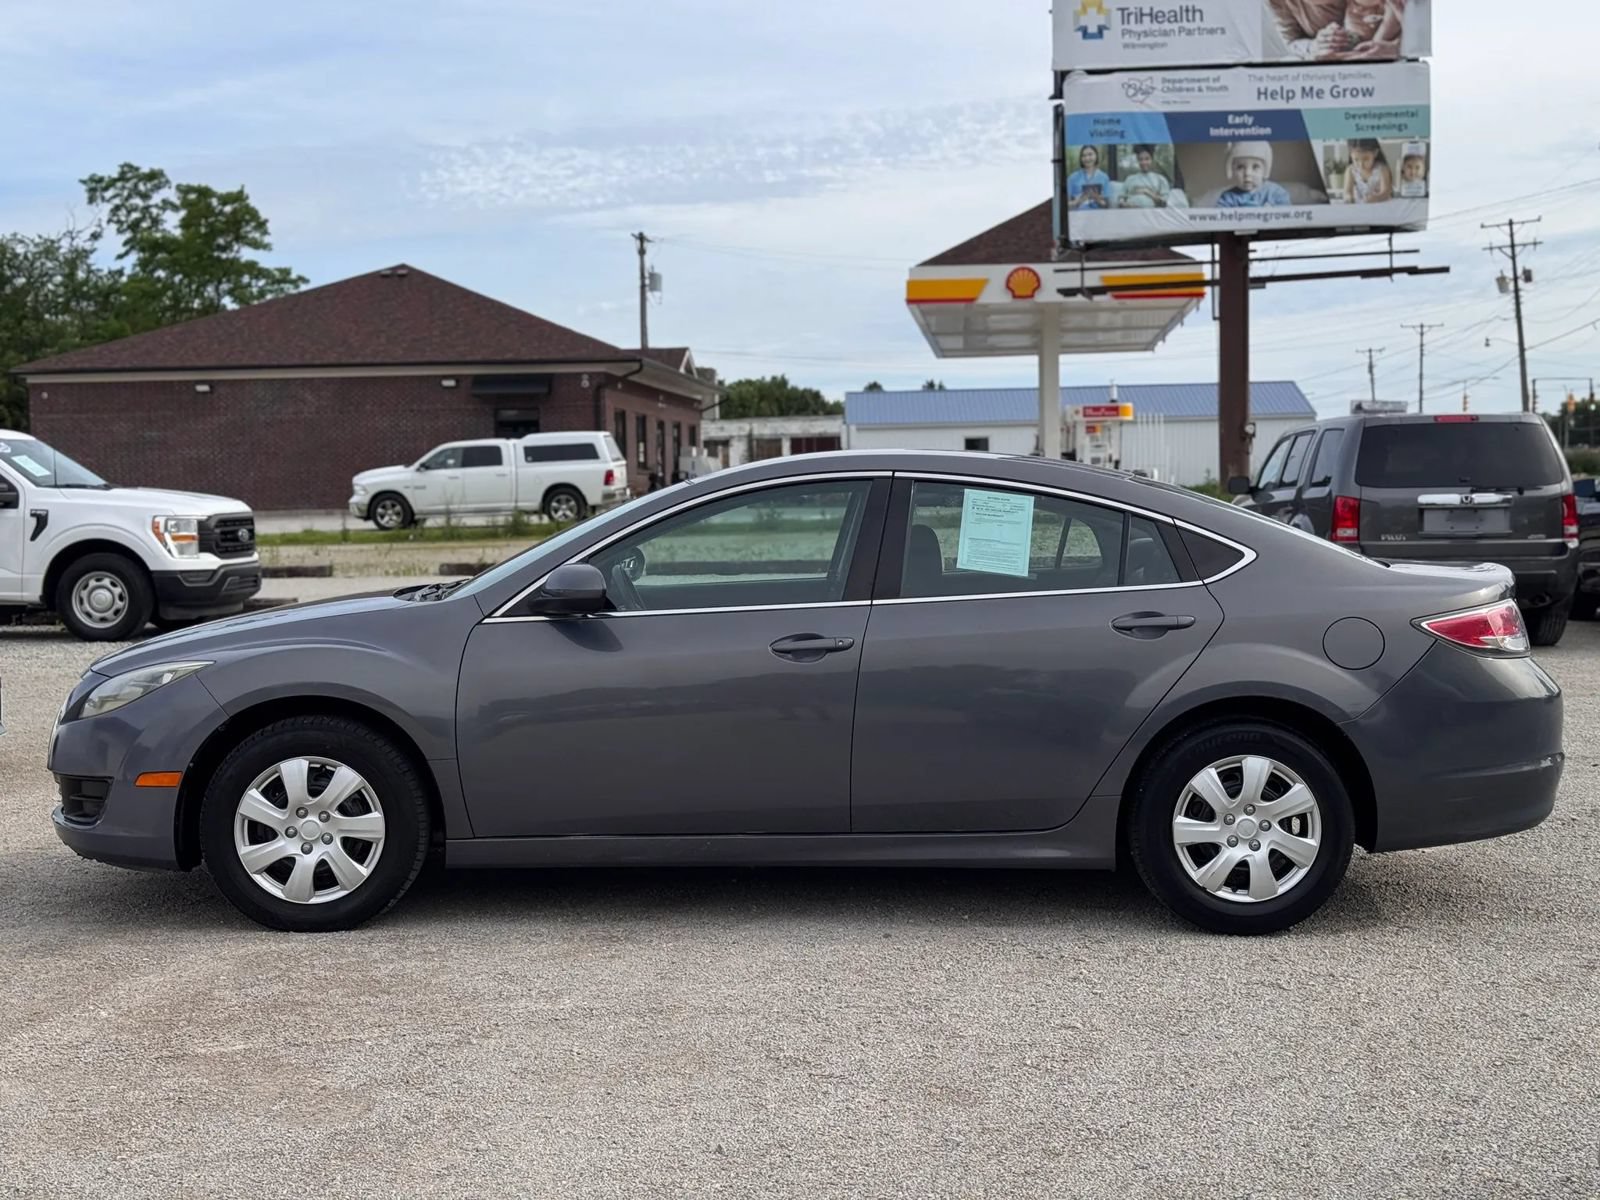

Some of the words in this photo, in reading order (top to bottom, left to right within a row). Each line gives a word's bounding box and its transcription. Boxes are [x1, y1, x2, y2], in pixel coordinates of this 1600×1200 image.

[1116, 5, 1204, 25] TriHealth
[1121, 28, 1176, 40] Physician
[1178, 26, 1226, 36] Partners
[1161, 77, 1210, 86] Department
[1212, 75, 1221, 83] of
[1247, 74, 1264, 82] The
[1291, 73, 1300, 81] of
[1302, 72, 1337, 82] thriving
[1257, 85, 1296, 104] Help
[1301, 85, 1325, 99] Me
[1330, 84, 1375, 99] Grow
[1227, 114, 1254, 125] Early
[1344, 110, 1419, 121] Developmental
[1209, 126, 1272, 136] Intervention
[1355, 123, 1409, 132] Screenings
[1088, 129, 1125, 139] Visiting
[1189, 210, 1313, 222] www.helpmegrow.org
